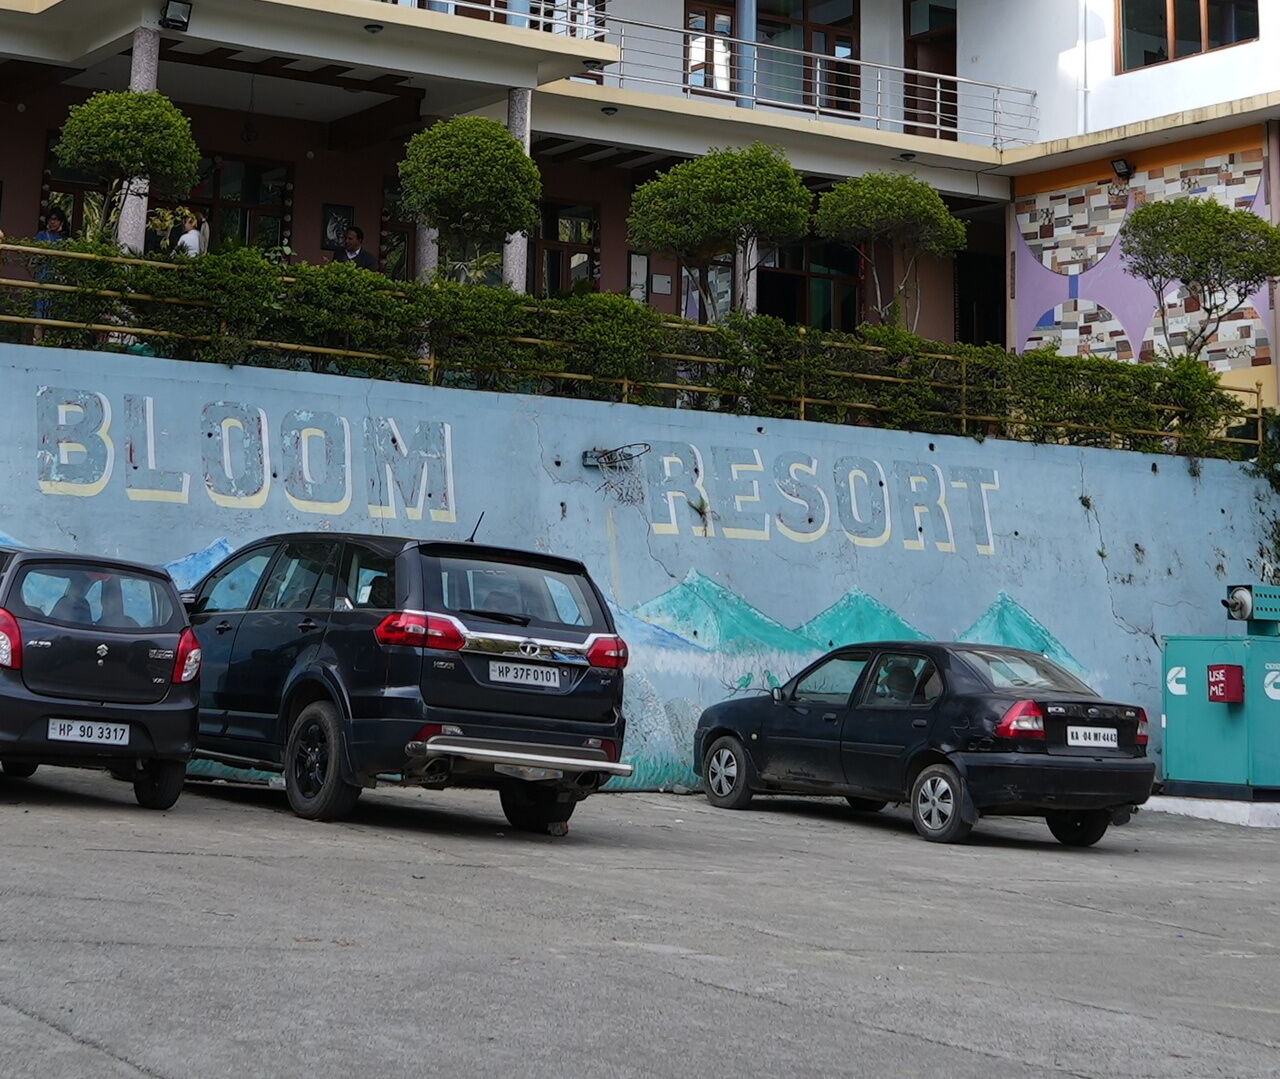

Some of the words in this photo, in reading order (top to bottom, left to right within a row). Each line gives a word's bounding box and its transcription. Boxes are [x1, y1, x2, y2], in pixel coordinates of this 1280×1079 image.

[37, 385, 456, 523] BLOOM
[650, 440, 1000, 555] RESORT
[498, 666, 511, 678] HP
[1209, 670, 1226, 682] USE
[1209, 684, 1224, 696] ME
[59, 724, 73, 736] HP
[79, 725, 93, 738] 90
[98, 727, 126, 740] 3317
[1070, 731, 1079, 740] KA
